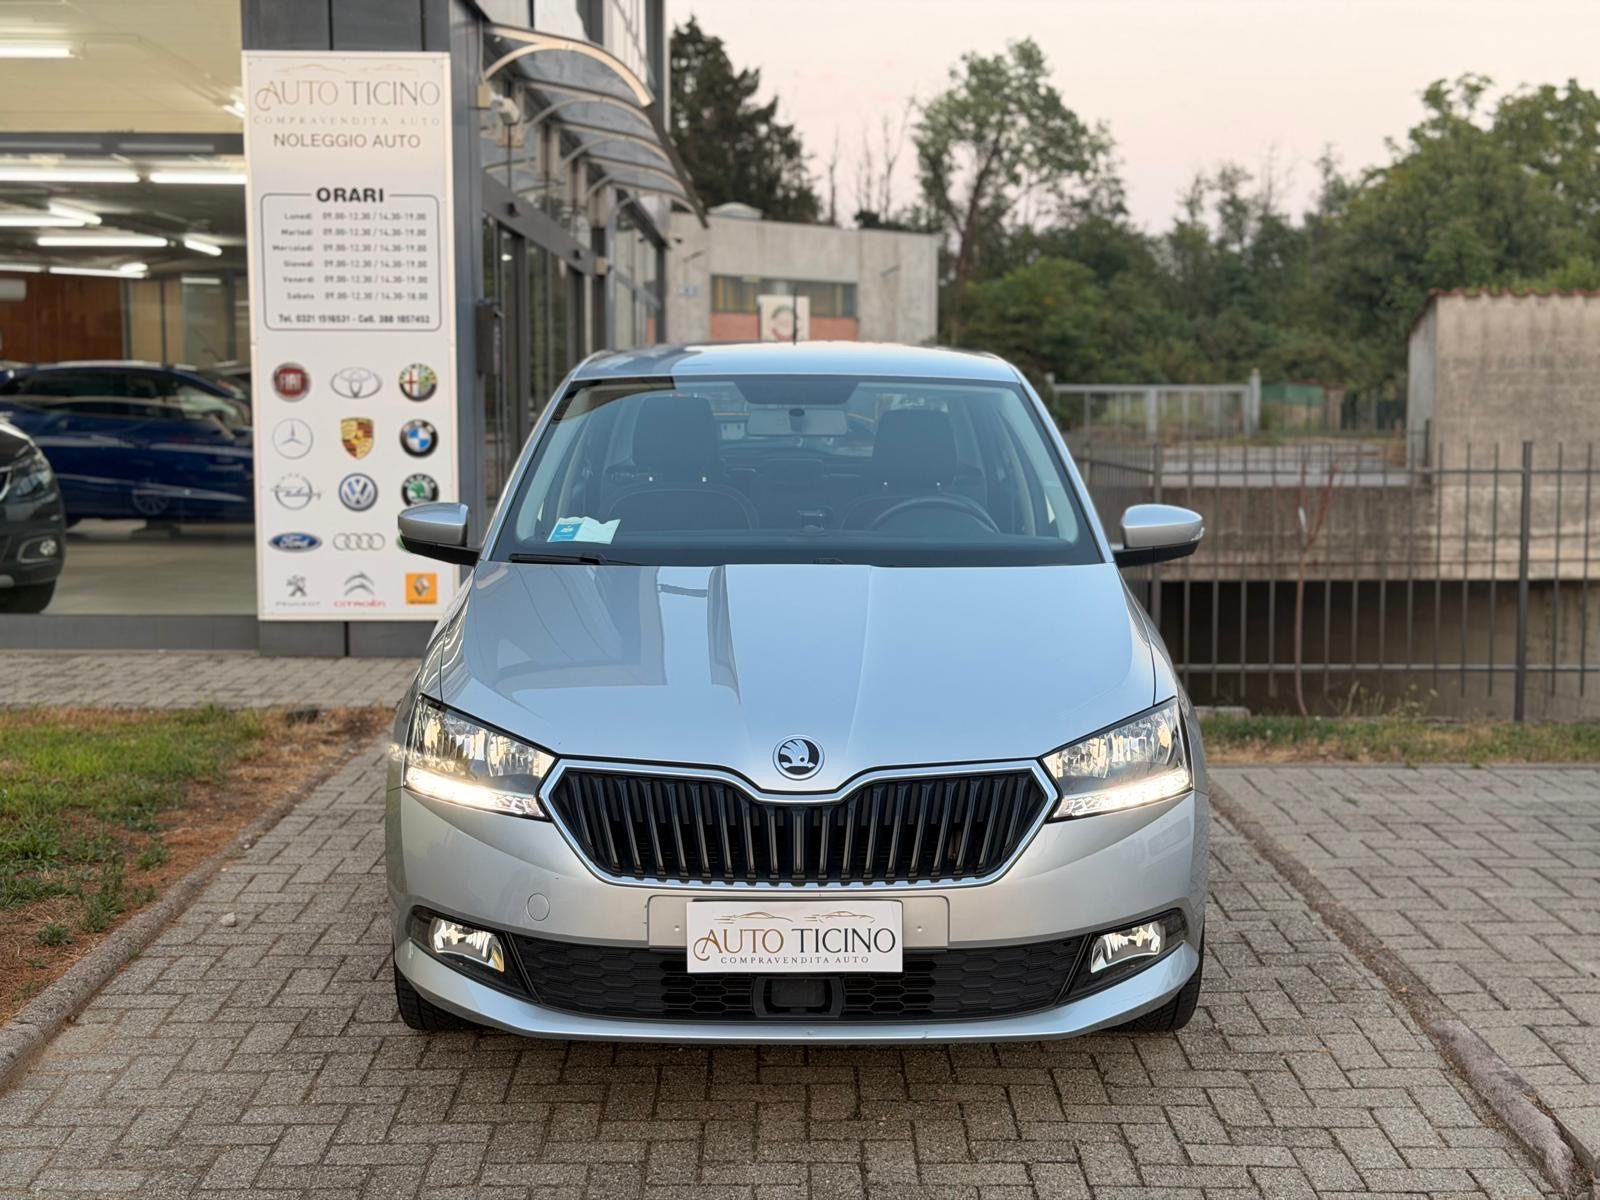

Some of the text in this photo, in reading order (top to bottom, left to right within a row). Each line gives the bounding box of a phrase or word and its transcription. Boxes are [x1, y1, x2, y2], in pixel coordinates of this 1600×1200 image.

[254, 80, 440, 111] AUTO TICINO
[253, 116, 440, 126] COMPRAVENDITA AUTO
[273, 133, 421, 148] NOLEGGIO AUTO
[316, 187, 384, 203] ORARI
[693, 928, 896, 961] AUTO TICINO
[720, 956, 869, 964] COMPRAVENDITA AUTO
